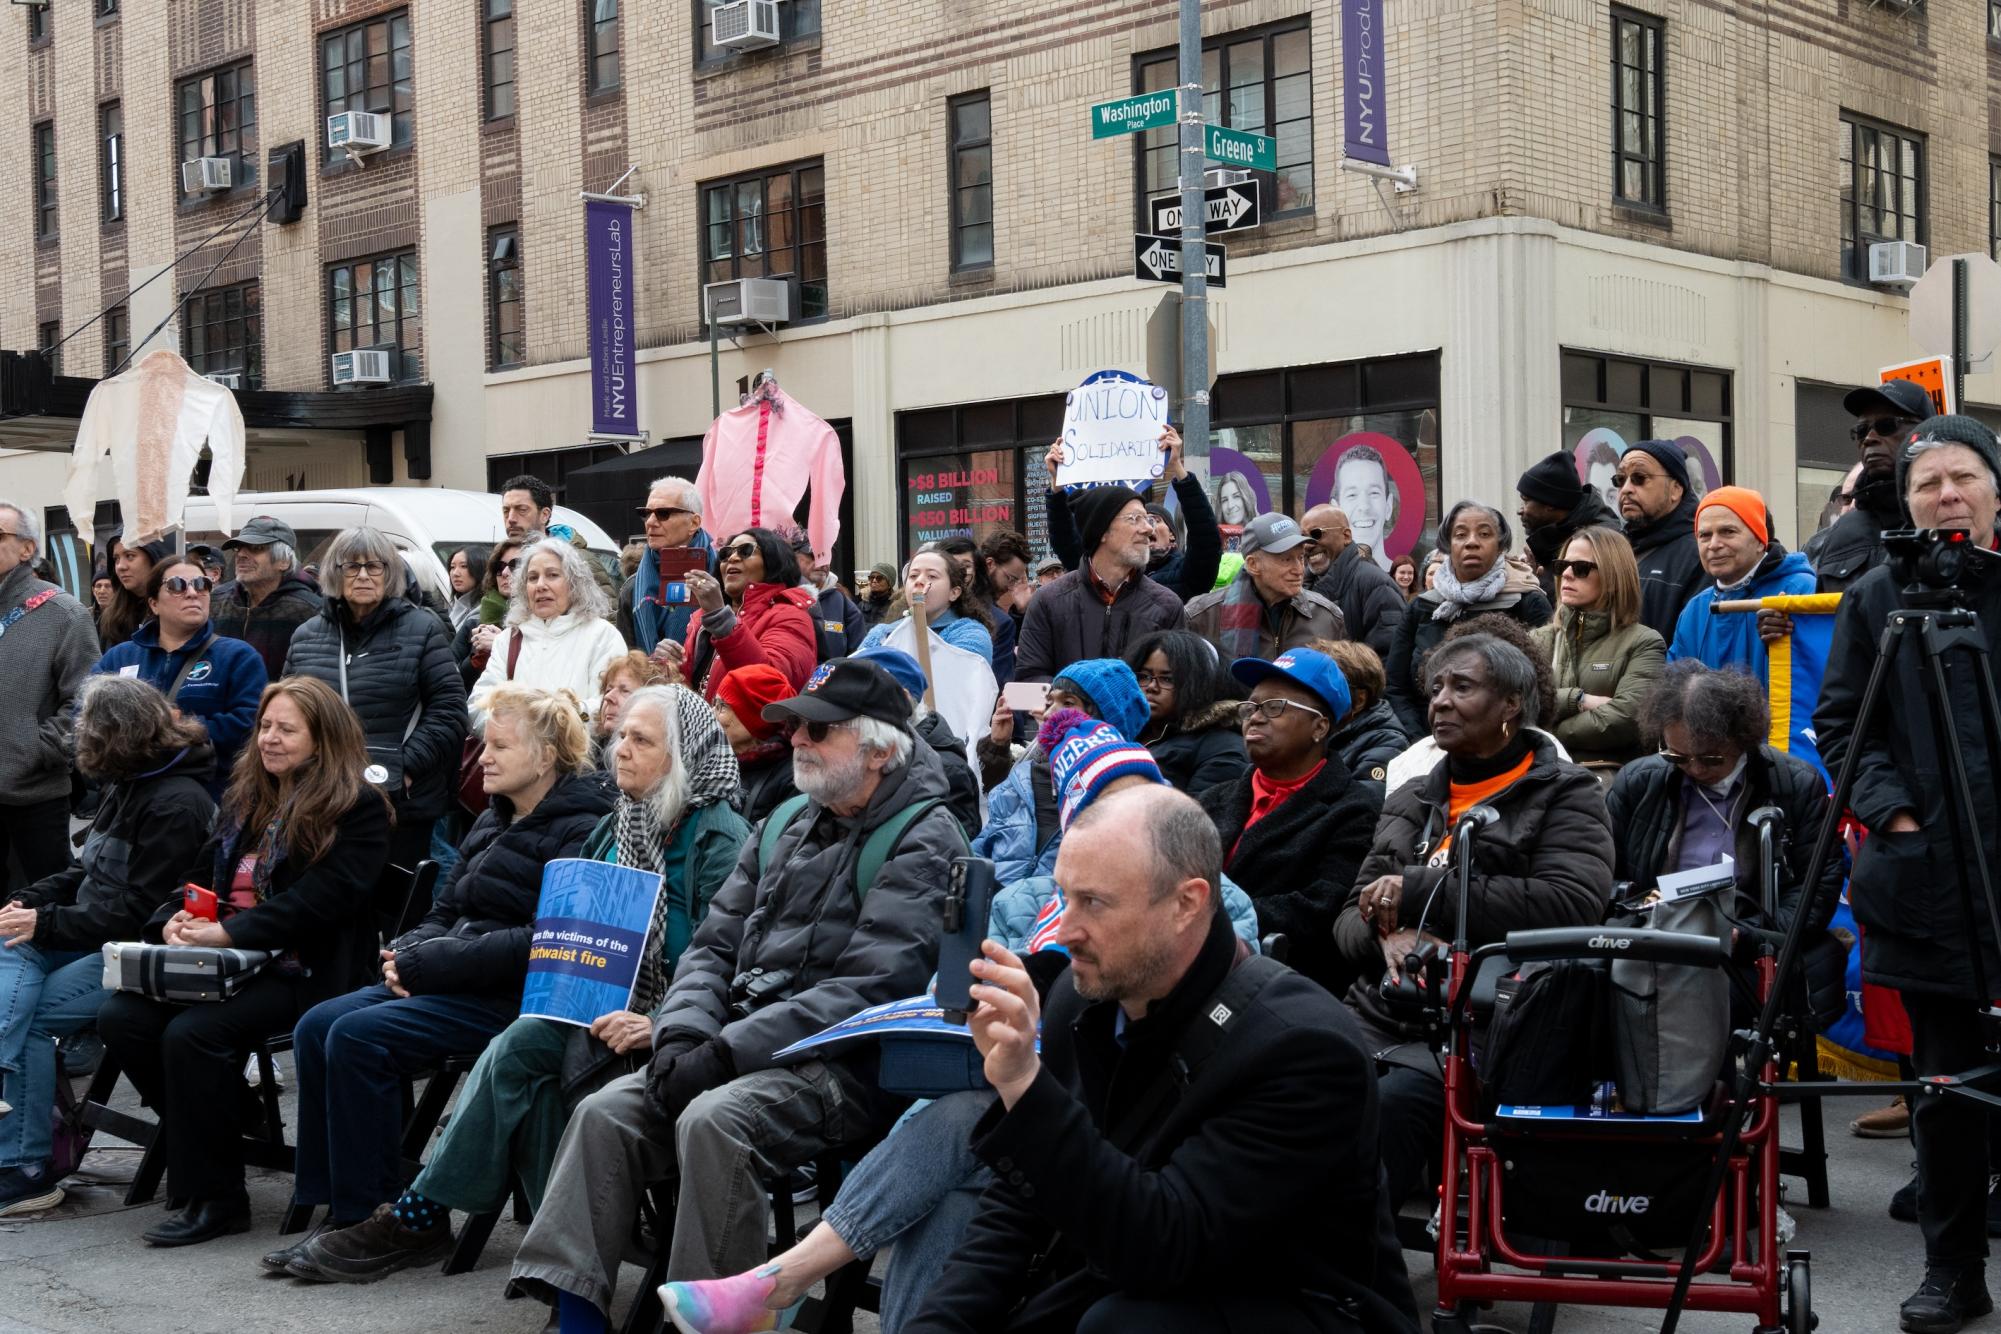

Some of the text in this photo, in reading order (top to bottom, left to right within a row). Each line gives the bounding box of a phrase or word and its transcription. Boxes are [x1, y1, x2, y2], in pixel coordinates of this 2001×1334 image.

[1100, 97, 1171, 124] Washington
[1127, 120, 1145, 131] Place
[1212, 130, 1266, 162] Greene St
[1166, 198, 1241, 227] ON WAY
[1149, 250, 1176, 270] ONE
[607, 219, 626, 419] NYUEntrepreneursLab
[1070, 386, 1159, 421] UNION
[938, 468, 998, 489] BILLION
[917, 492, 953, 504] RAISED
[949, 505, 1010, 525] BILLION
[918, 528, 973, 542] VALUATION
[542, 929, 555, 940] the
[556, 930, 593, 945] victims
[595, 938, 609, 948] of
[610, 939, 629, 953] the
[1587, 934, 1632, 949] drive
[580, 948, 607, 968] fire
[1584, 1189, 1650, 1214] drive
